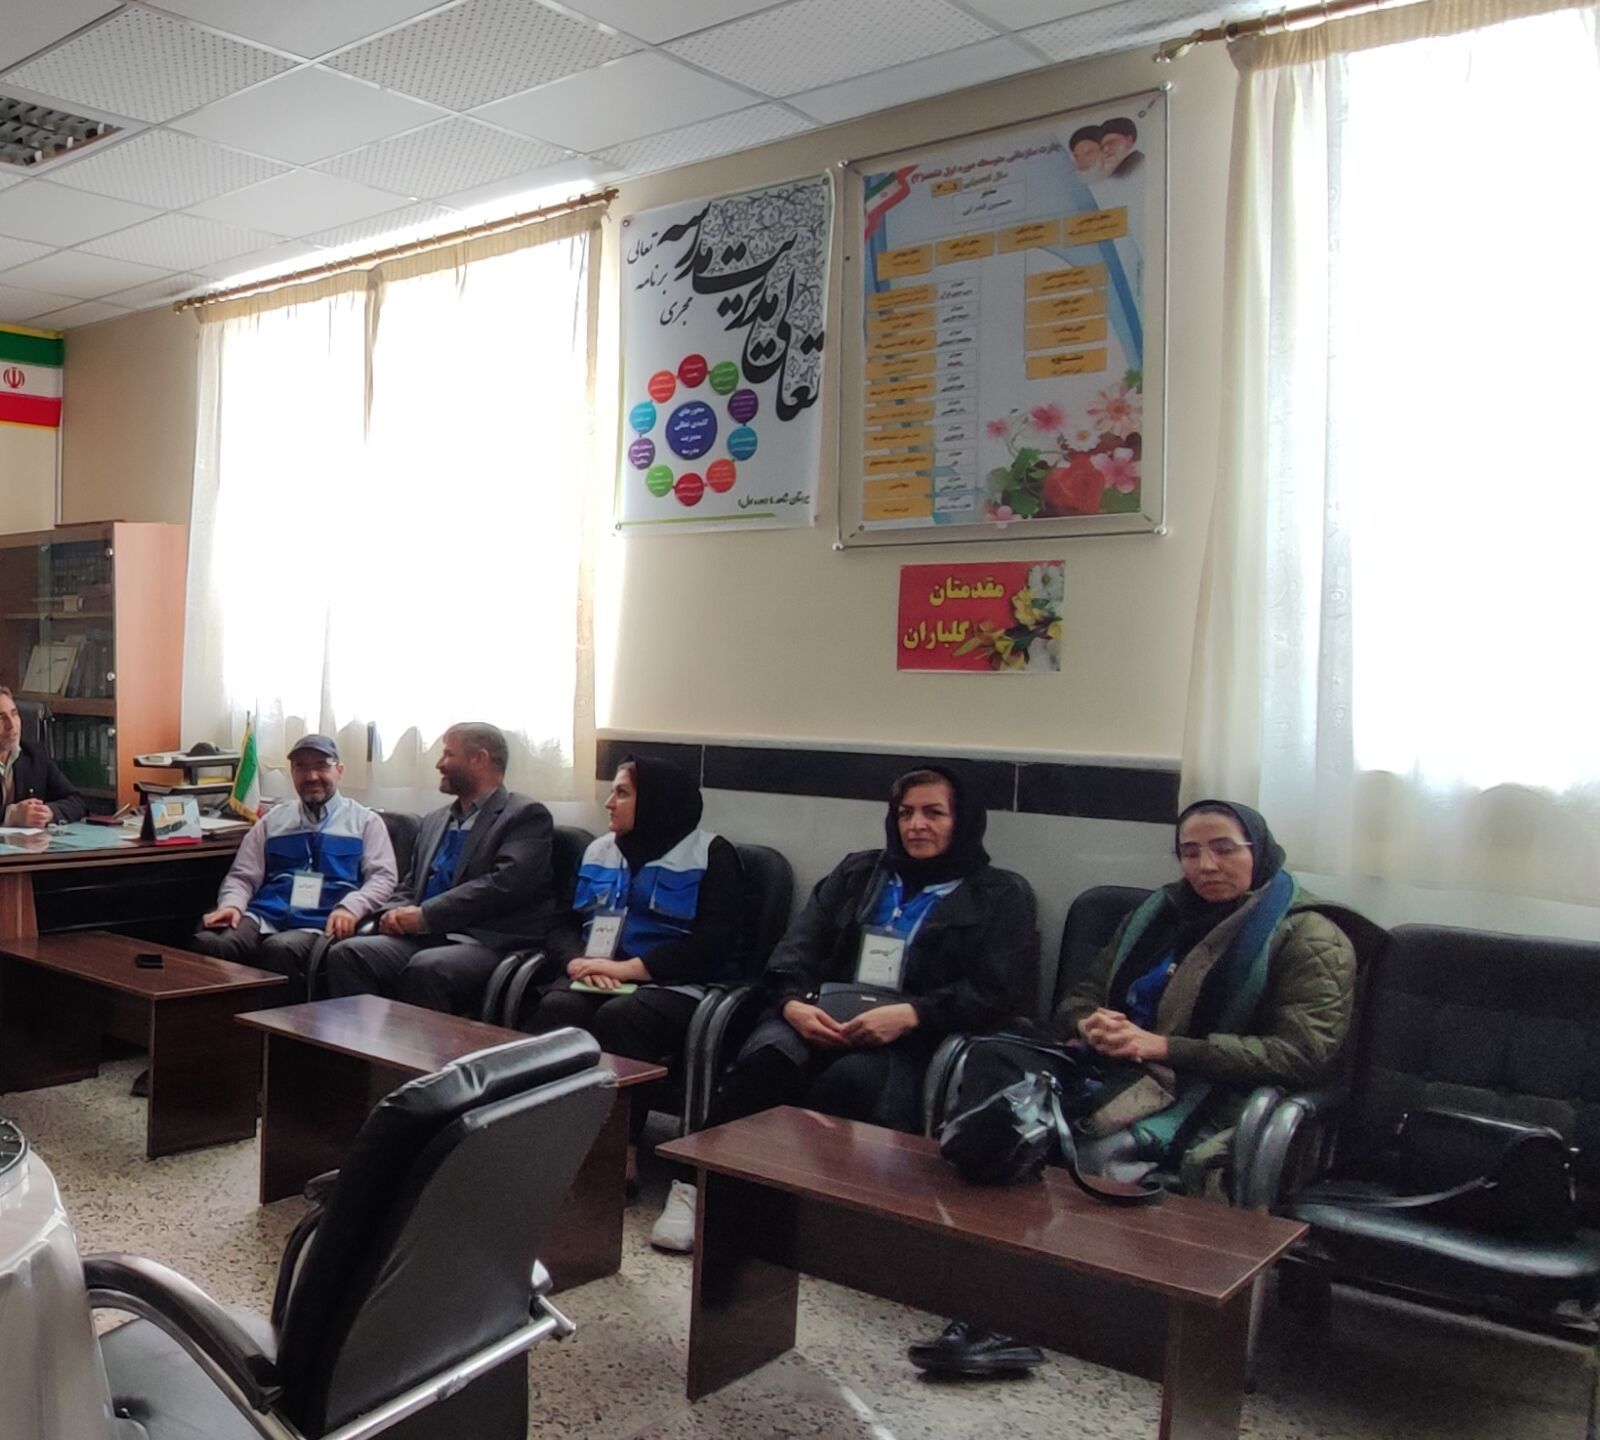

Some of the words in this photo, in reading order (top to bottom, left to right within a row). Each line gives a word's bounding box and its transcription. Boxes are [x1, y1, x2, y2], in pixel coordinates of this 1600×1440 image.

[627, 232, 658, 264] تعالی
[634, 265, 668, 295] برنامه
[660, 297, 694, 326] مجری
[929, 577, 1005, 606] مقدمتان
[903, 619, 971, 650] گلباران
